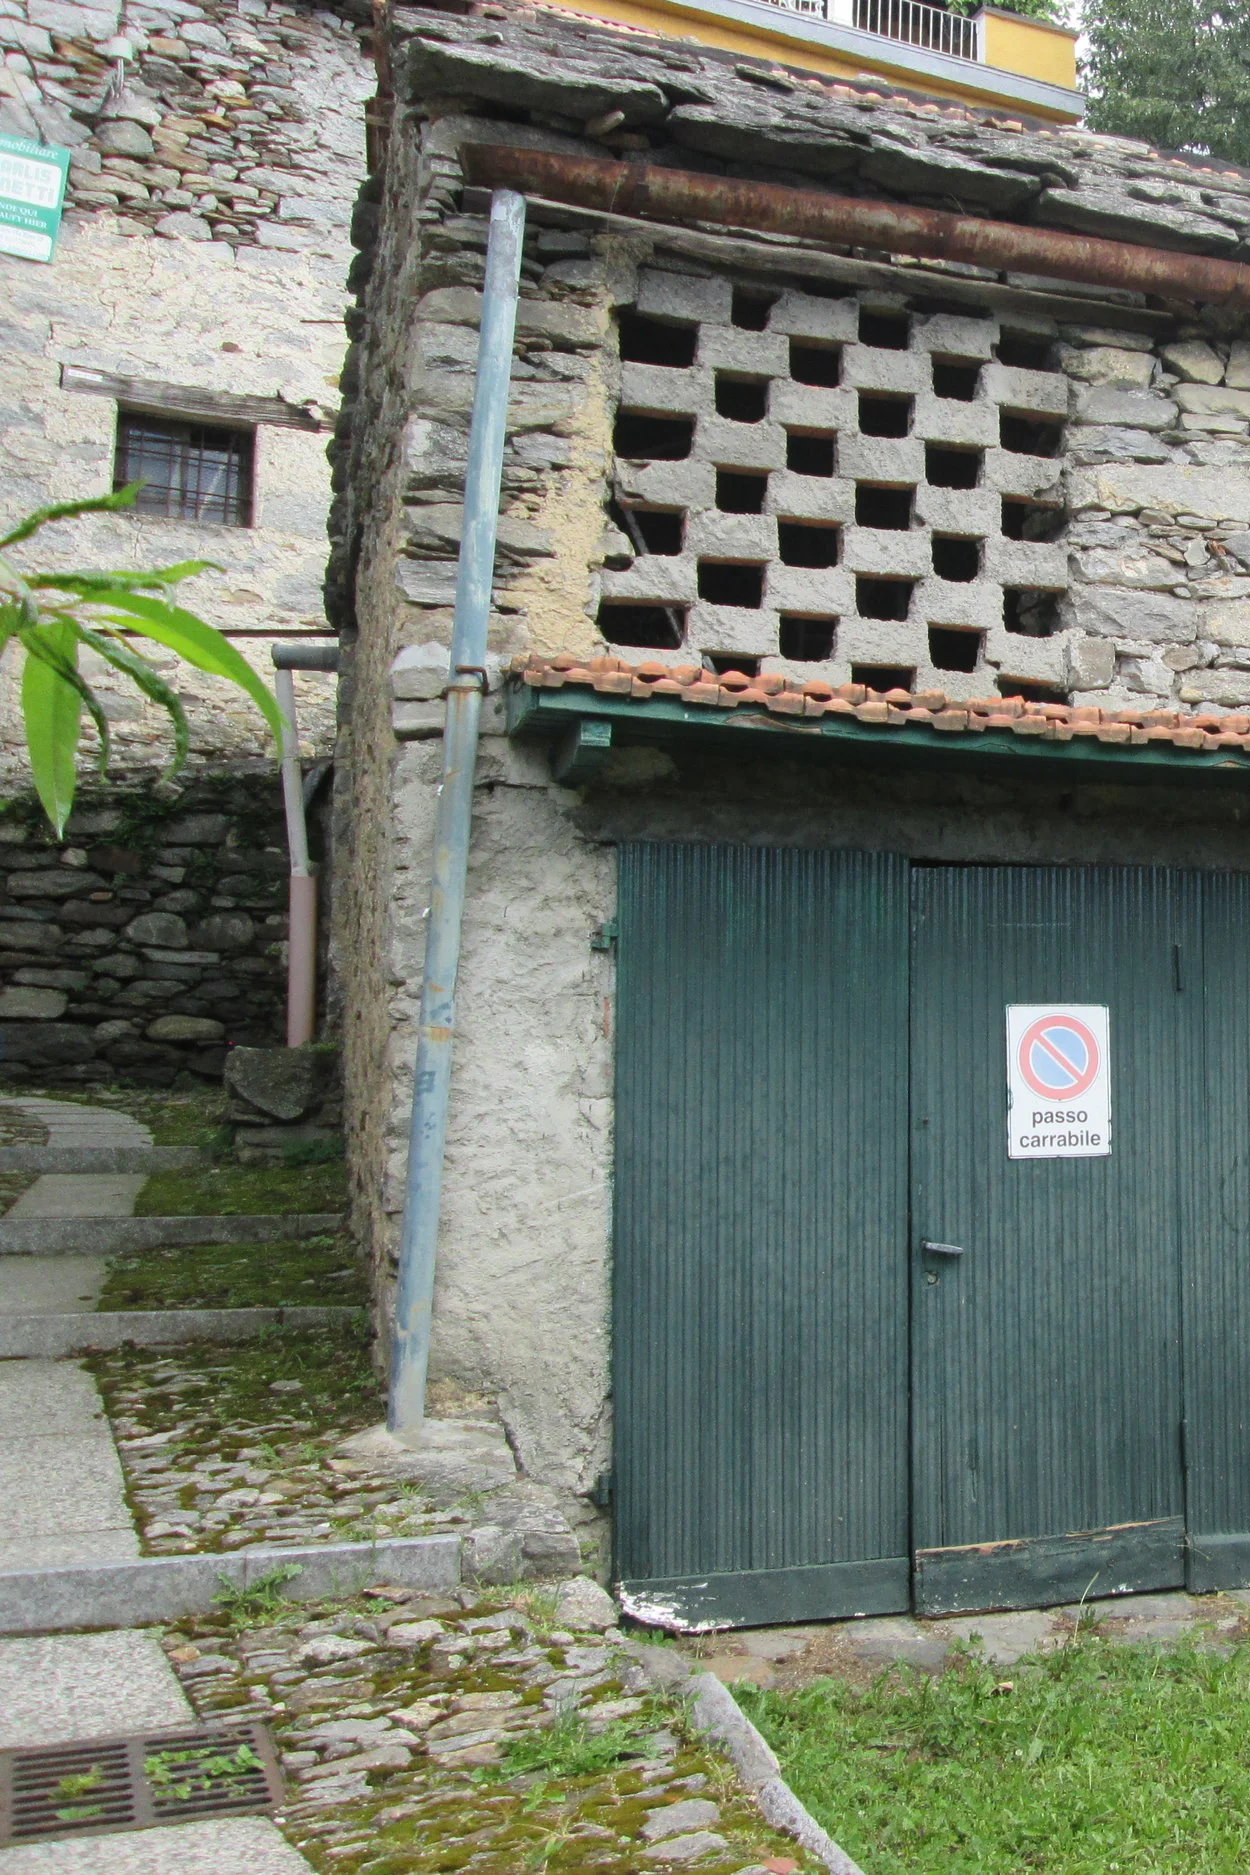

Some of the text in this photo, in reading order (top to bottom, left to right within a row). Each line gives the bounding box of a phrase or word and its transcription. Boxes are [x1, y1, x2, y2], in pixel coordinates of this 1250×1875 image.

[20, 207, 38, 218] QUI
[24, 217, 48, 229] HIER
[1032, 1110, 1088, 1128] passo
[1020, 1130, 1101, 1148] carrabile
